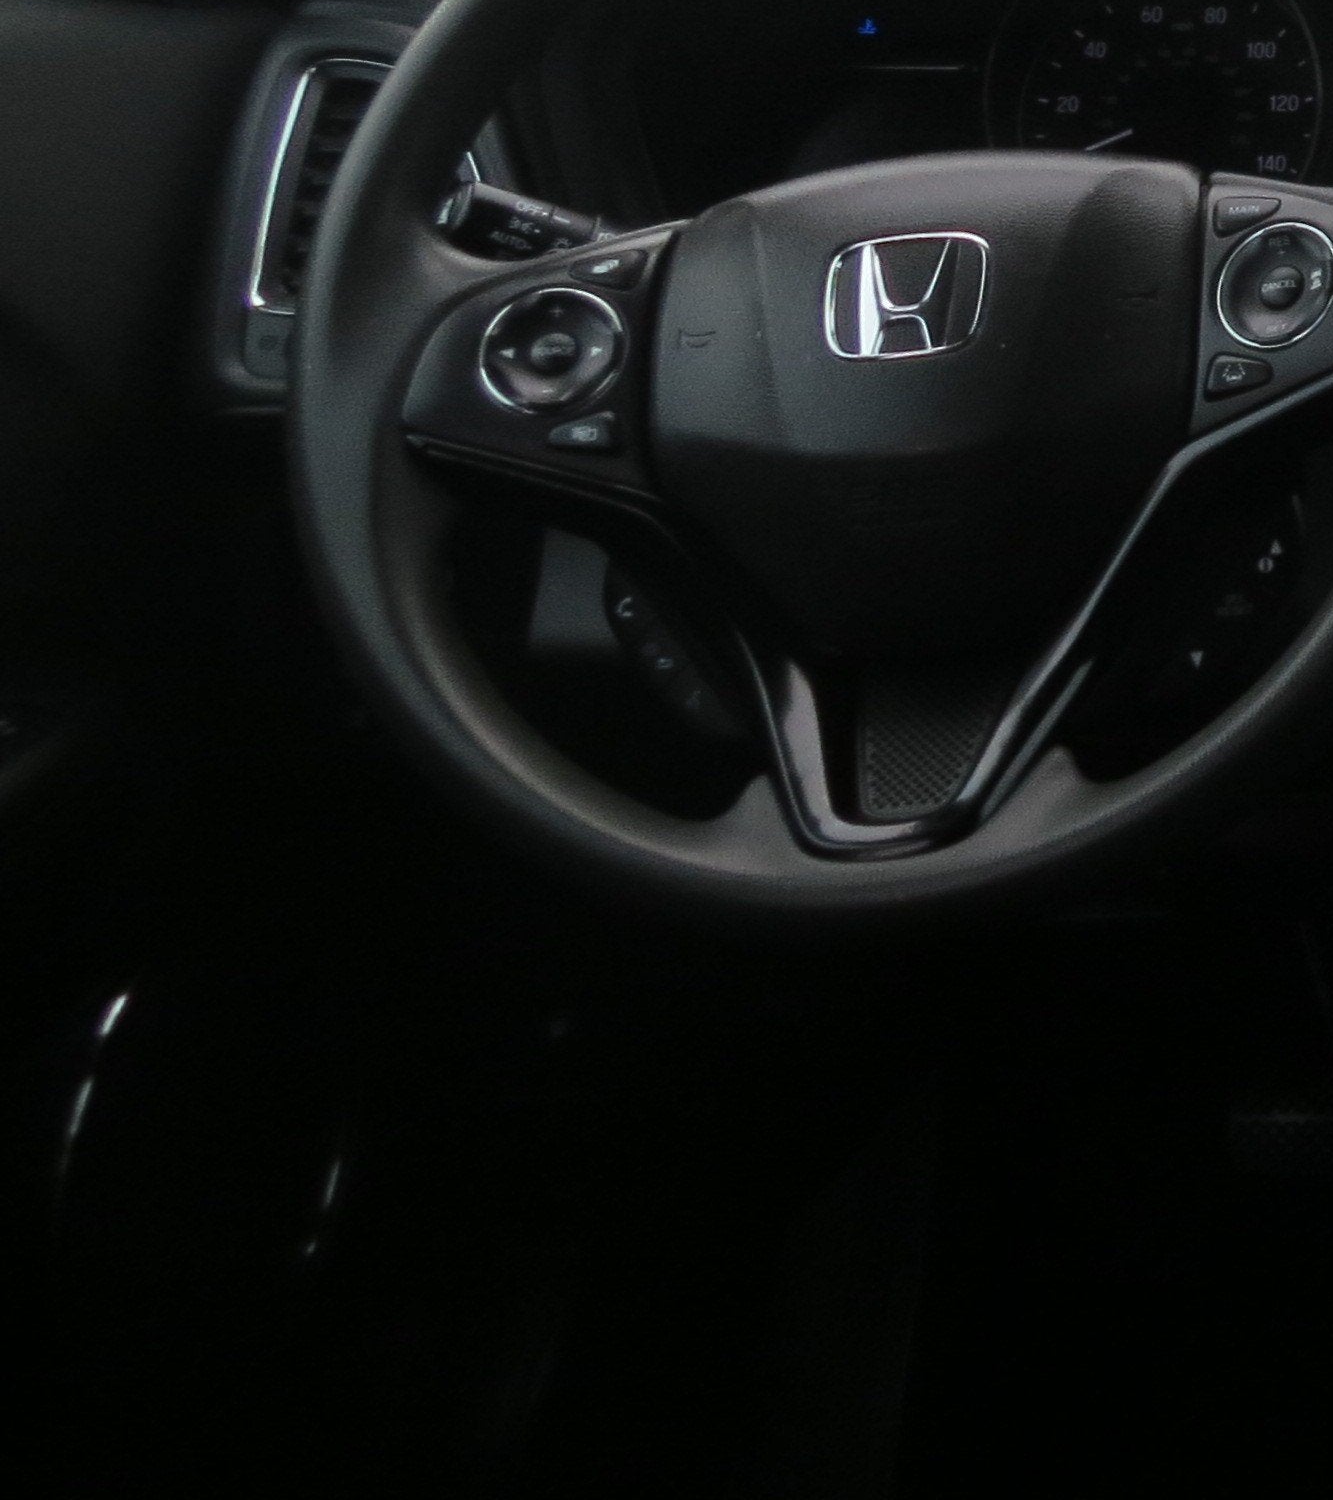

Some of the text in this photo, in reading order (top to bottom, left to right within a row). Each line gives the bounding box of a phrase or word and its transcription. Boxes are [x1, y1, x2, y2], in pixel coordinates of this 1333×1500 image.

[1140, 6, 1163, 23] 60
[1204, 6, 1227, 24] 80
[1083, 42, 1107, 59] 40
[1246, 41, 1277, 59] 100
[1056, 96, 1080, 113] 20
[1269, 95, 1300, 112] 120
[1256, 155, 1287, 173] 140
[1228, 205, 1260, 215] MAIN
